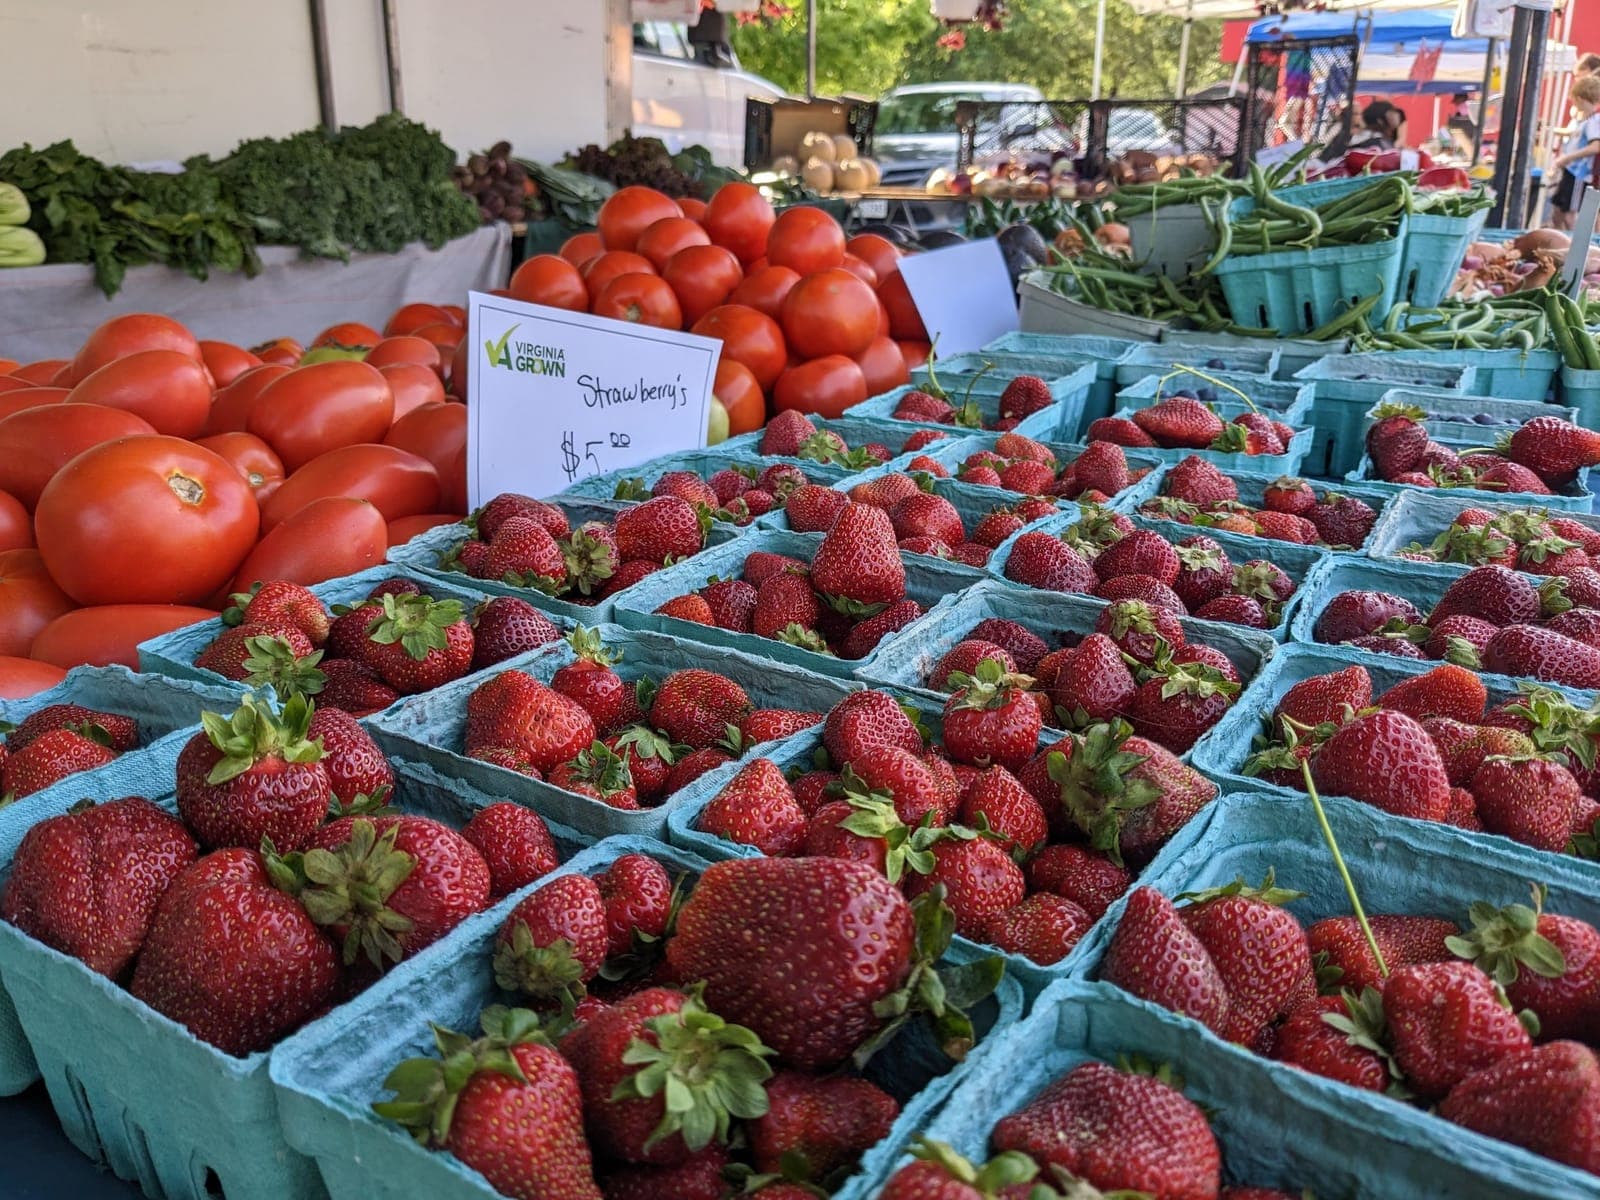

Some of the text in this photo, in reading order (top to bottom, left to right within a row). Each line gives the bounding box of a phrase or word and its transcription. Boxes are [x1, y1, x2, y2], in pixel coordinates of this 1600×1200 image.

[515, 341, 566, 361] VIRGINIA
[515, 355, 566, 378] GROWN
[577, 374, 688, 410] Strawberry's
